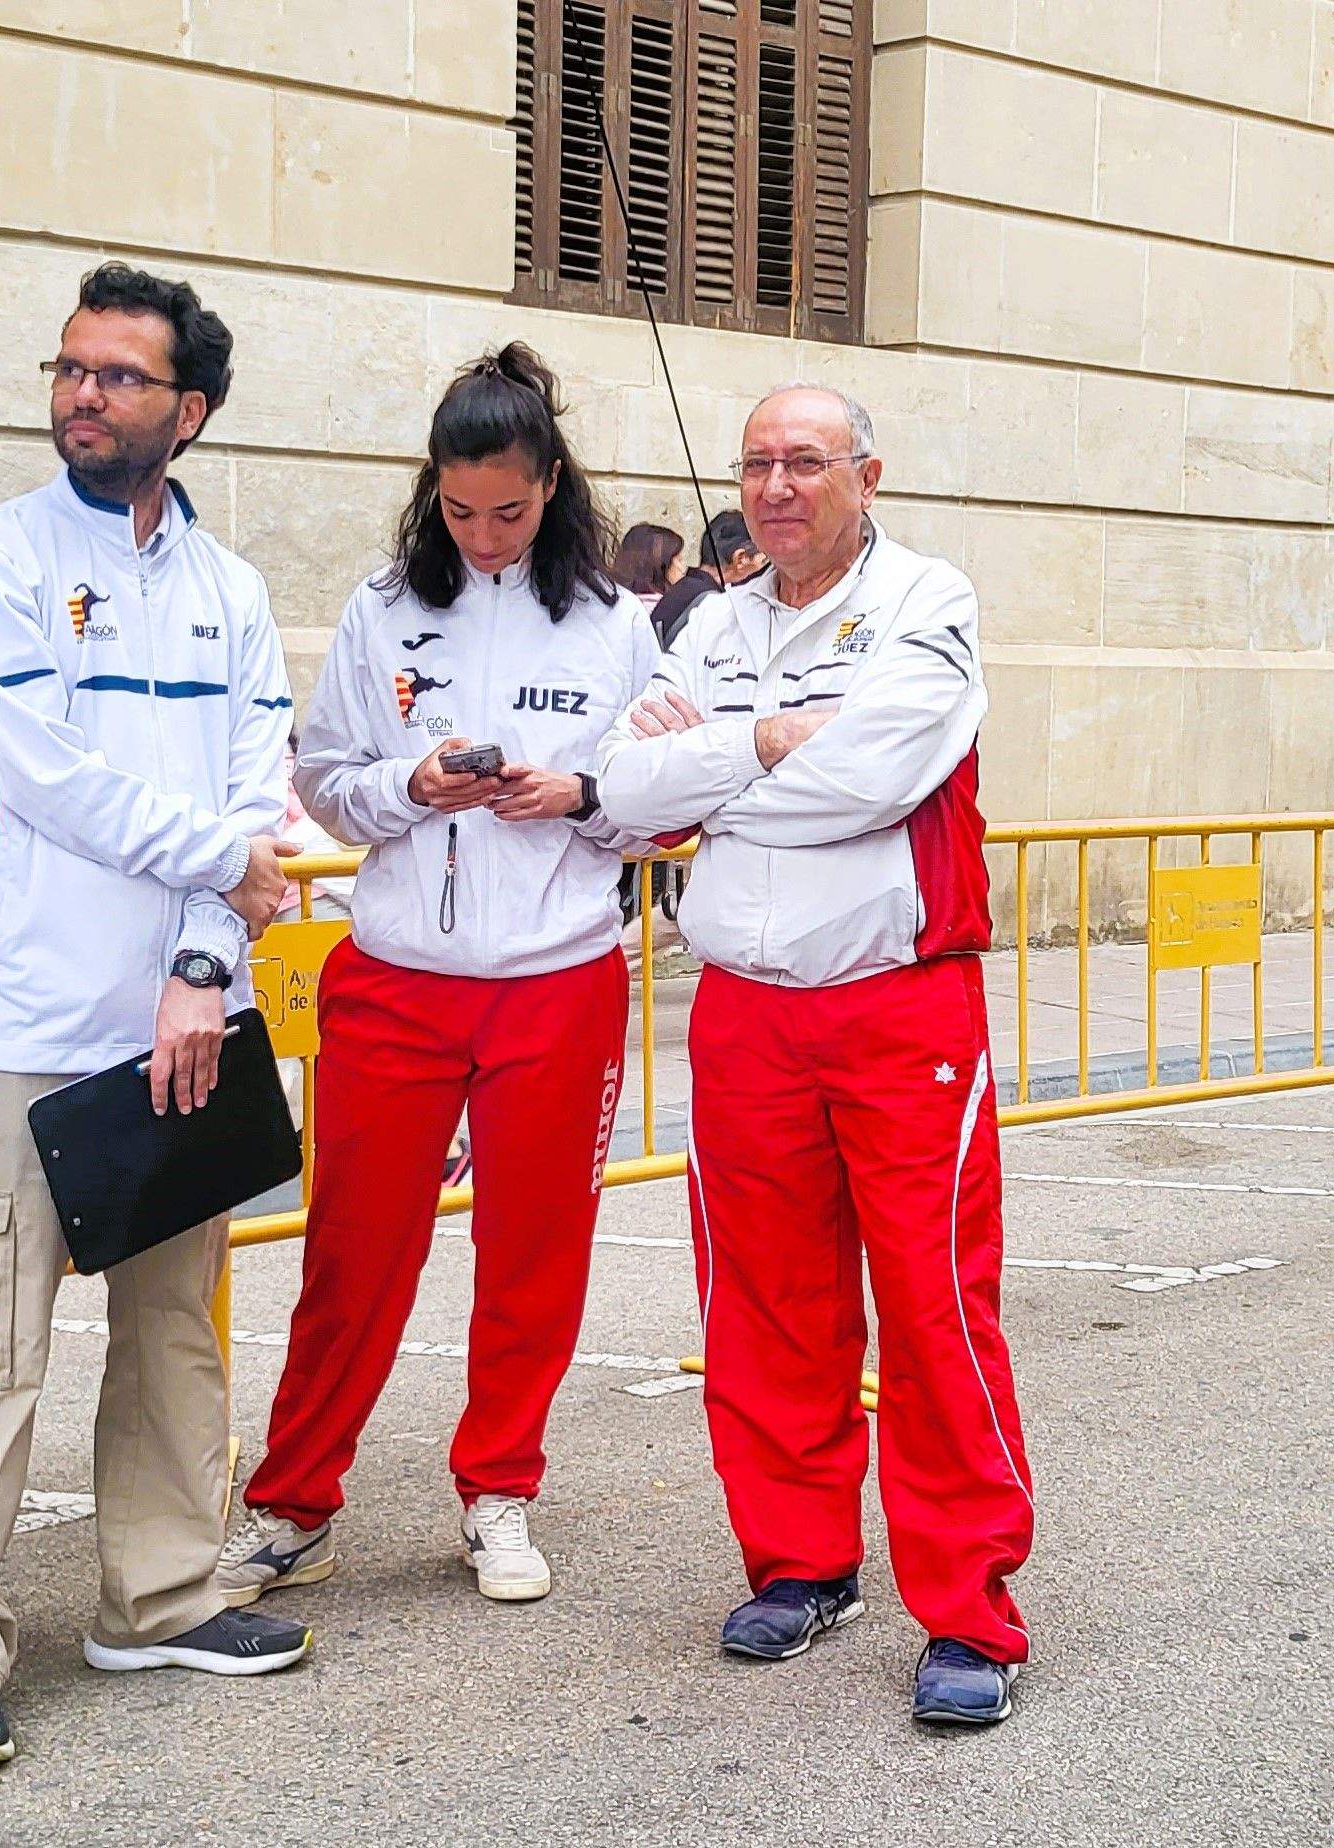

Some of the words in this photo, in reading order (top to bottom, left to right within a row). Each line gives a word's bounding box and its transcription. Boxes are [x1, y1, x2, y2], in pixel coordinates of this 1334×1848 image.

[191, 623, 221, 640] JUEZ
[833, 642, 869, 657] JUEZ
[512, 685, 589, 717] JUEZ
